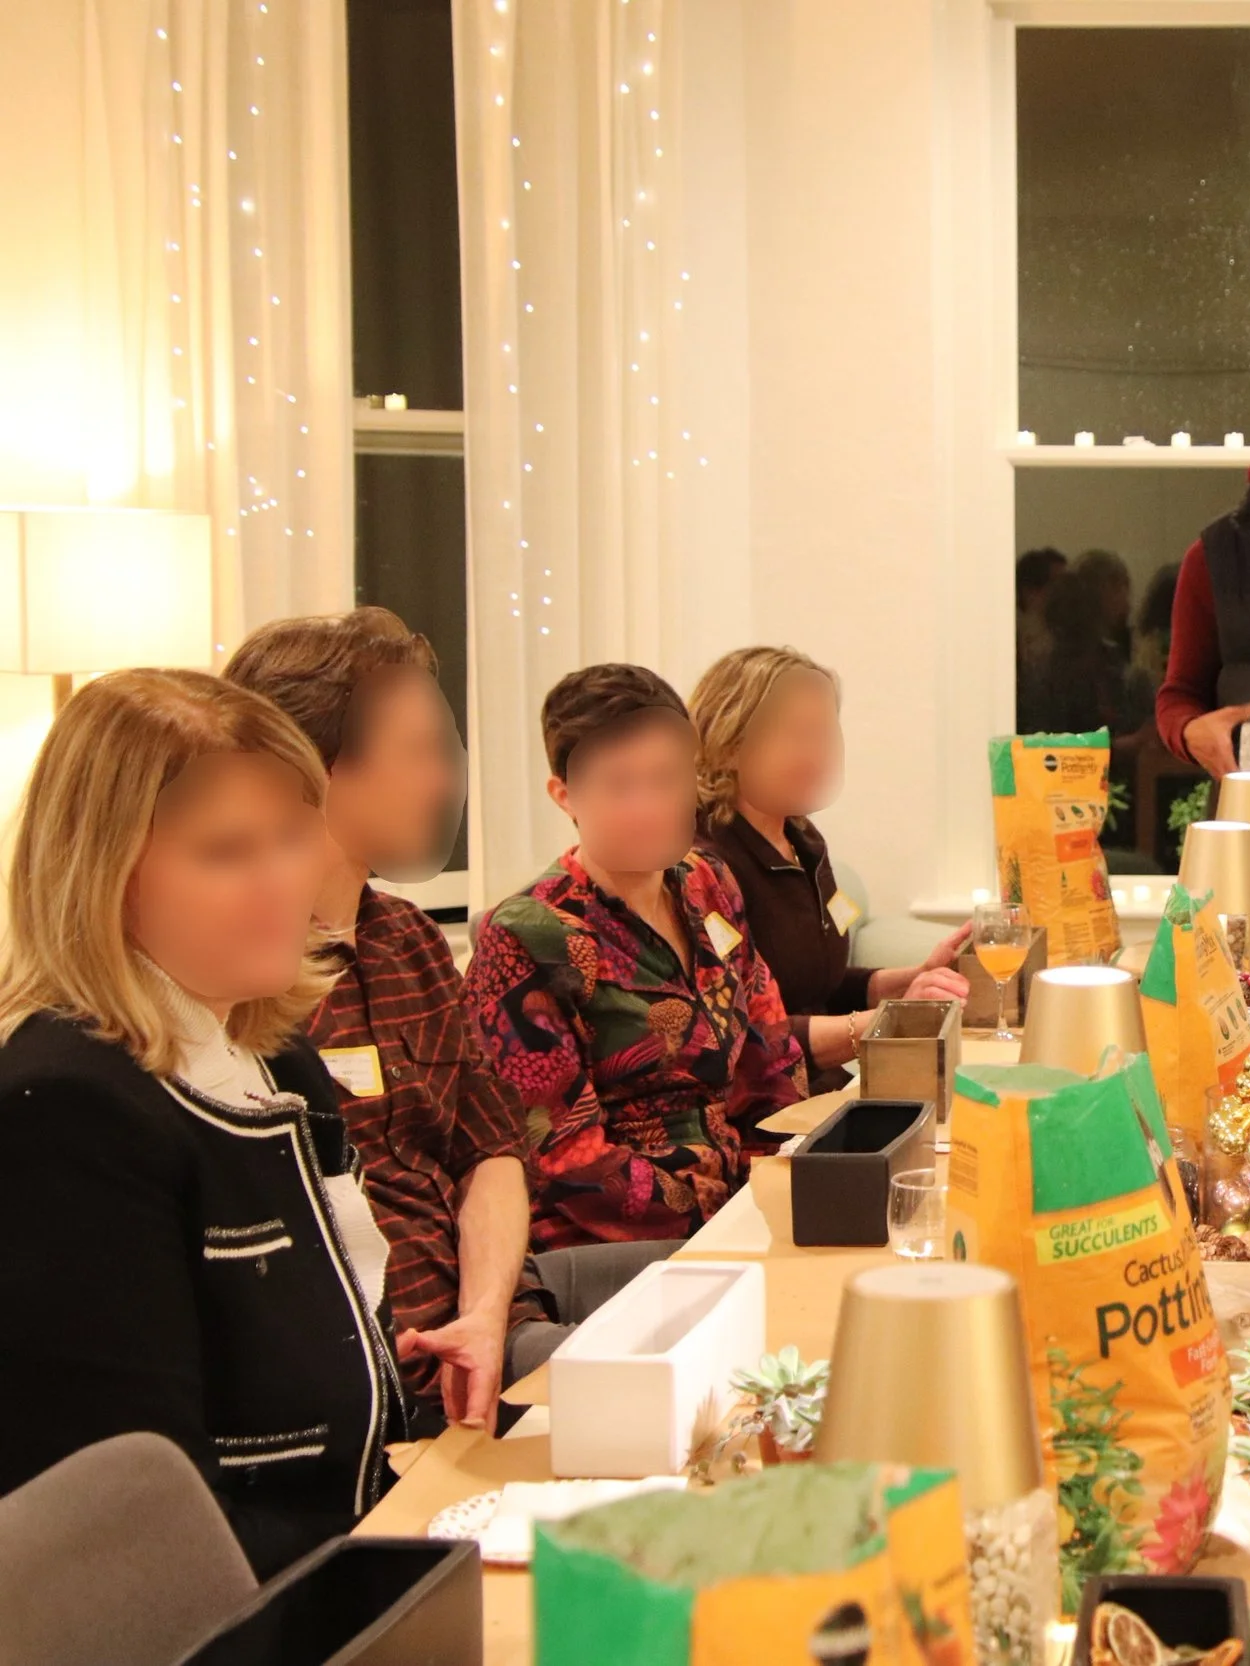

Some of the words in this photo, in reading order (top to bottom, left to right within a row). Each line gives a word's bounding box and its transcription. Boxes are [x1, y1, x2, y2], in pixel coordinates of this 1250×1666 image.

[1049, 1217, 1094, 1240] GREAT
[1052, 1214, 1158, 1259] SUCCULENTS
[1096, 1269, 1213, 1359] Pottin
